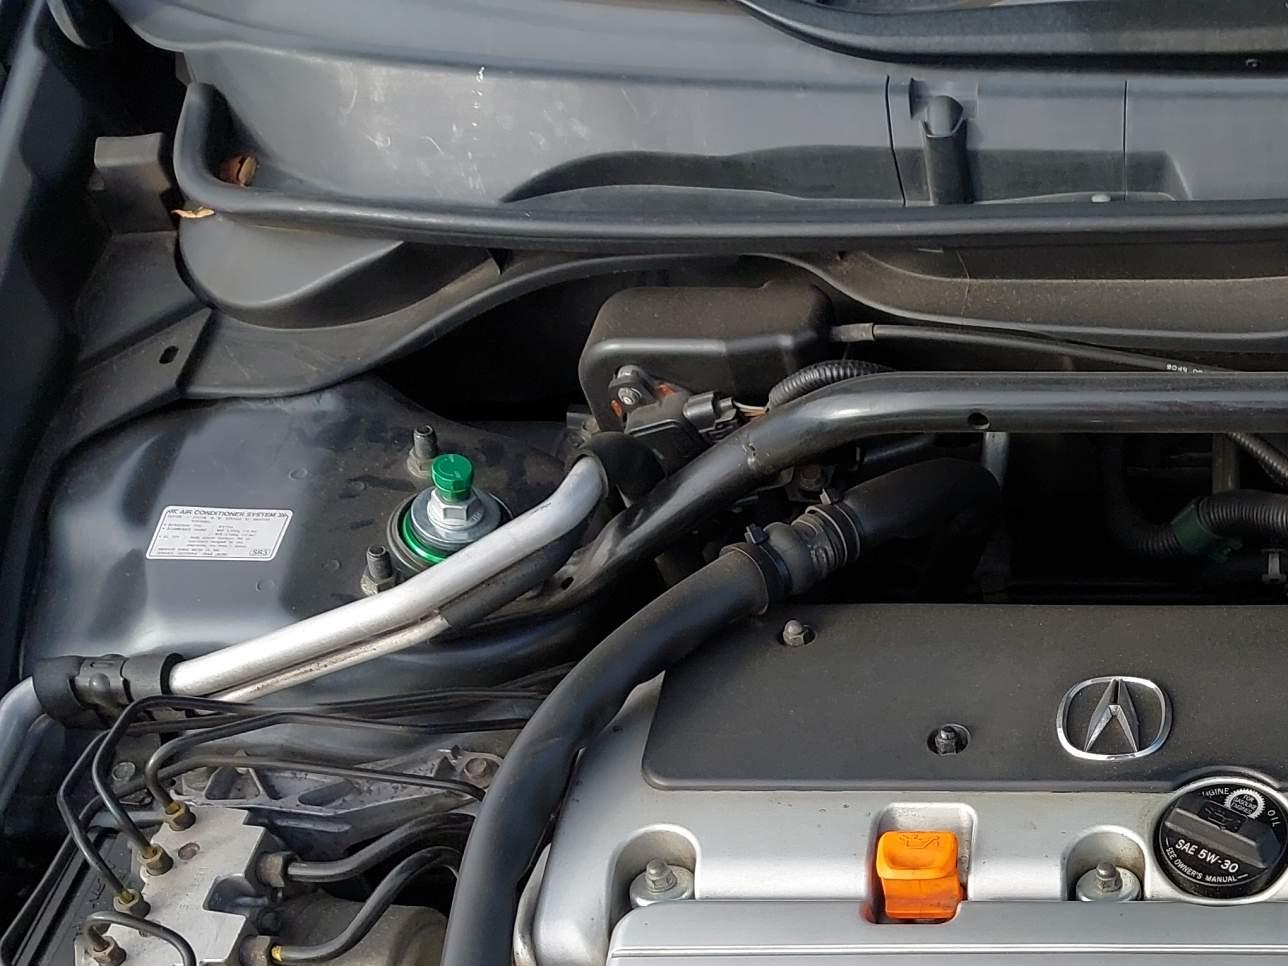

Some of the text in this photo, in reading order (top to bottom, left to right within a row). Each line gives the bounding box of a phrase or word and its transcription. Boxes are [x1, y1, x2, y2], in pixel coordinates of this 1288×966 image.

[1267, 809, 1281, 827] OIL
[1165, 846, 1238, 884] SEE OWNER'S MANUAL
[1175, 838, 1239, 874] SAE 5W-30
